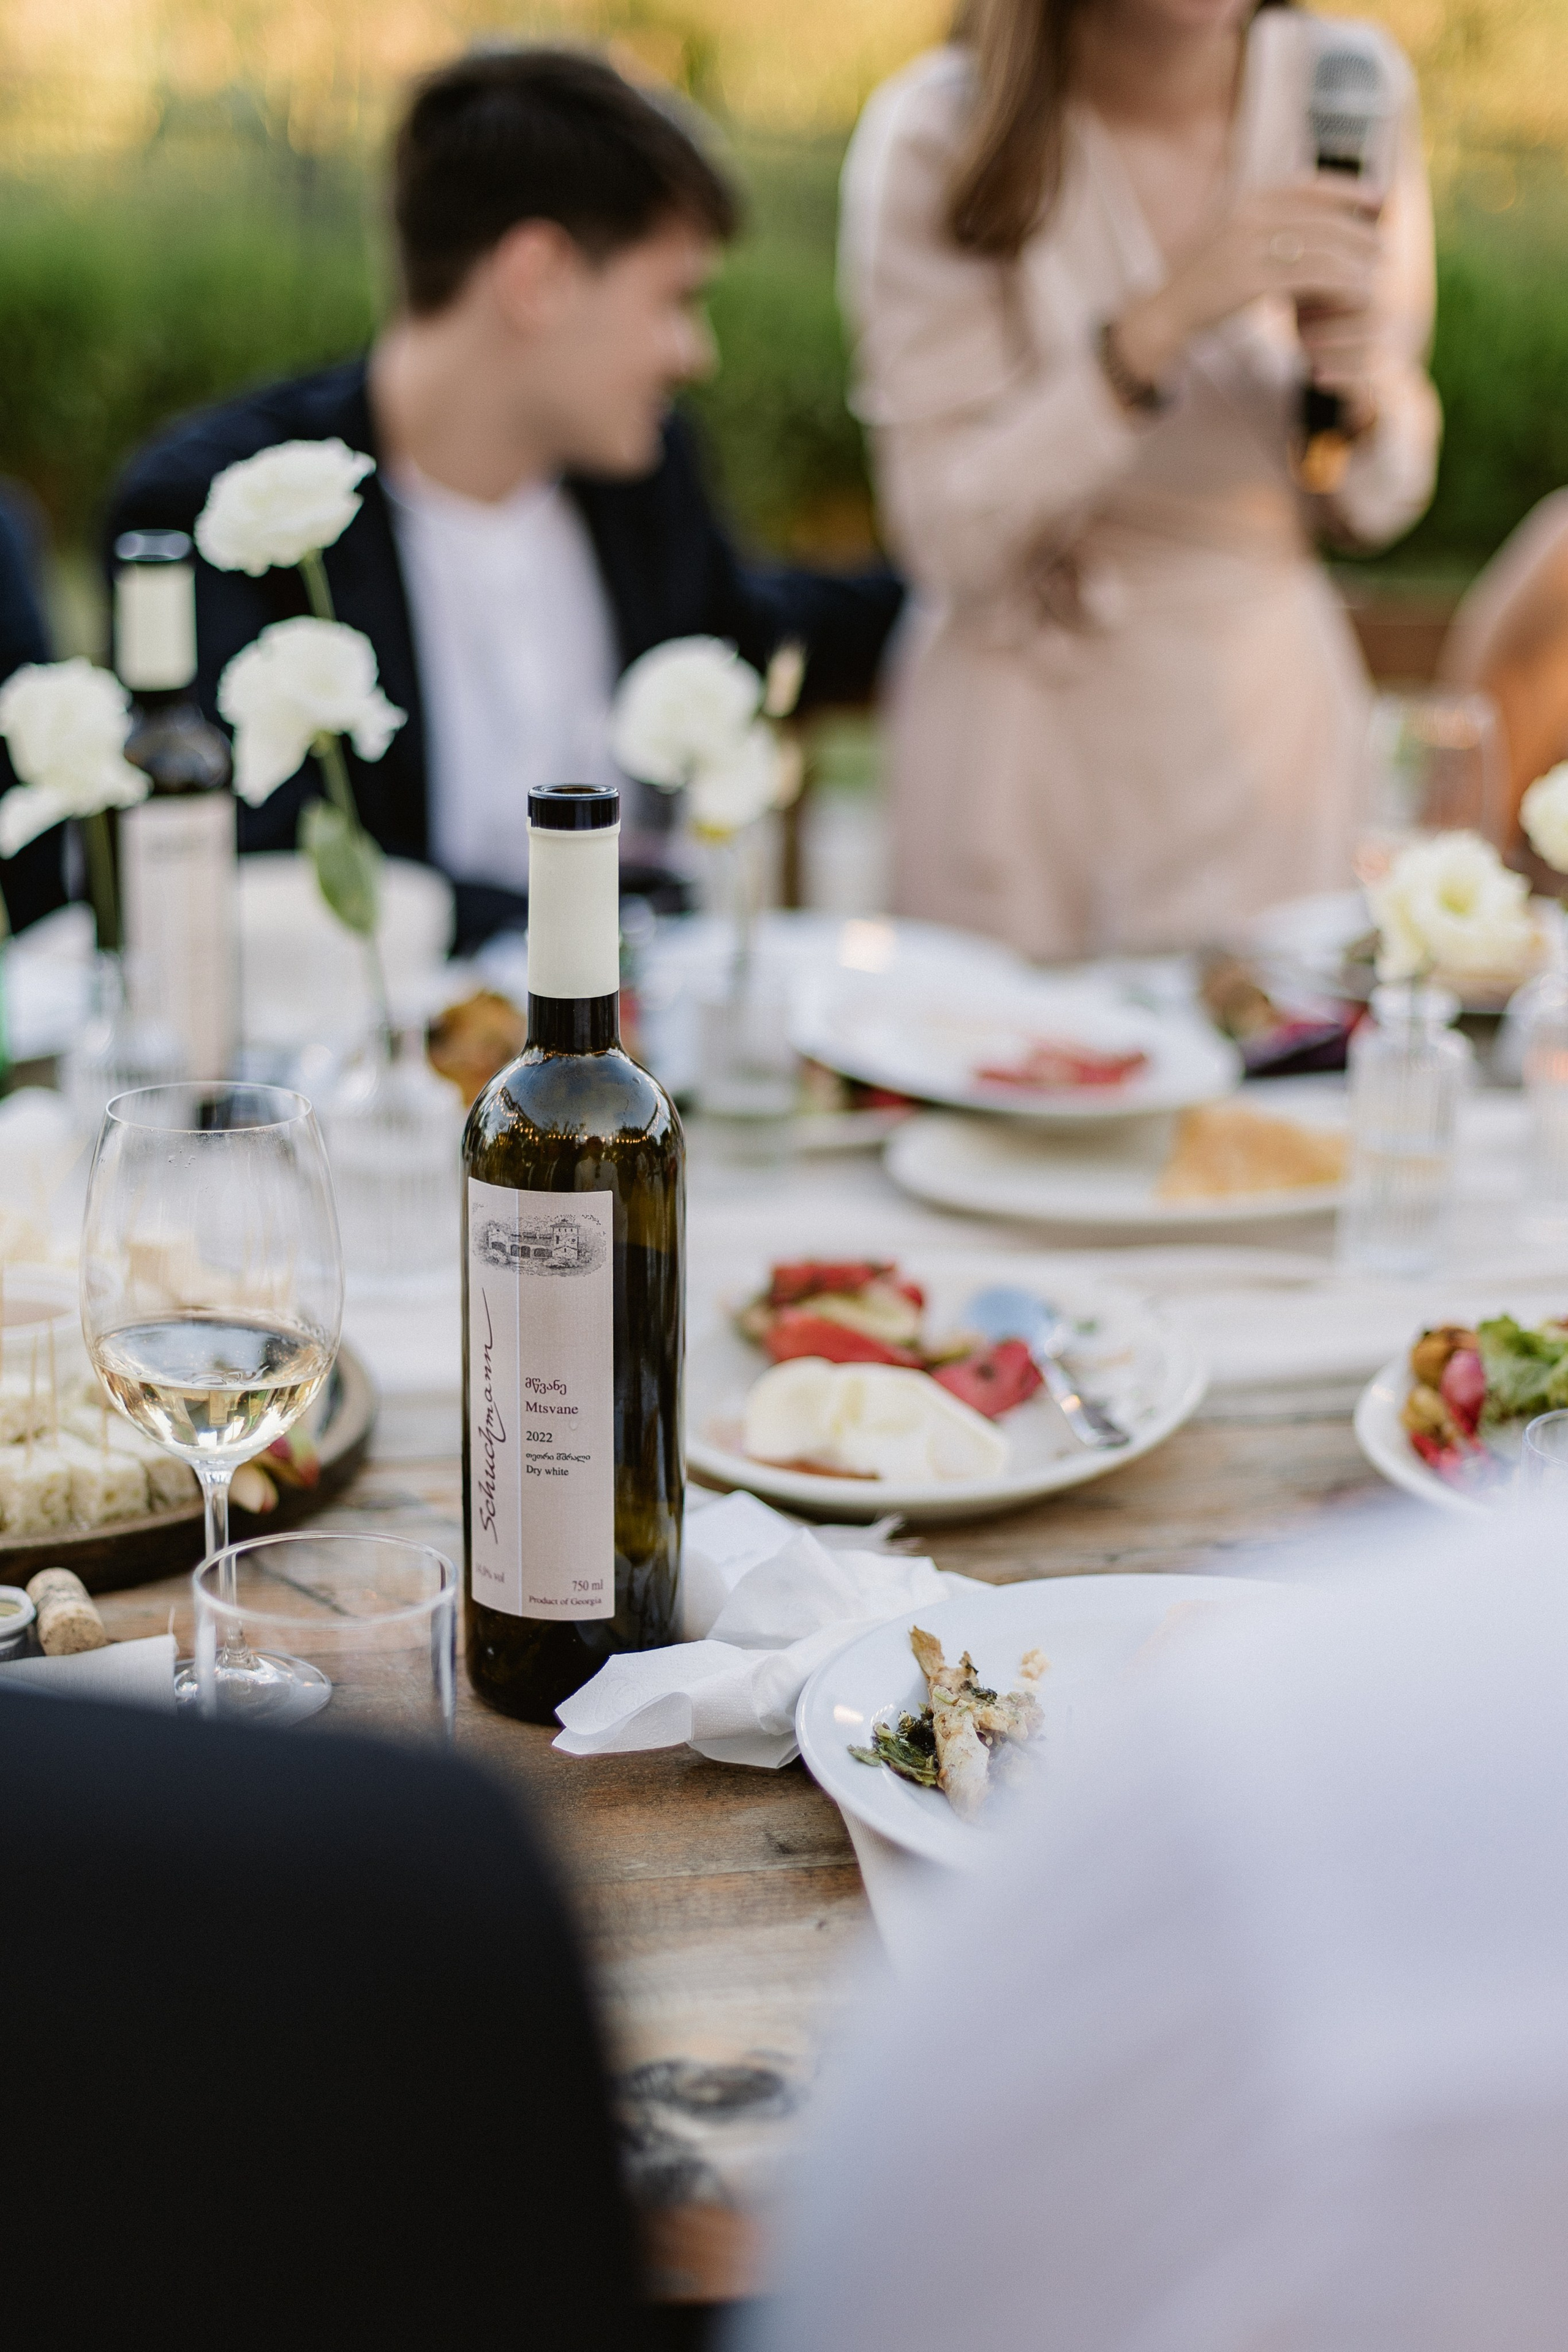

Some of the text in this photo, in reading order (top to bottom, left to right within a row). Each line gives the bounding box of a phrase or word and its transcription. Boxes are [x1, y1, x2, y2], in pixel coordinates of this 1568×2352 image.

[525, 1377, 567, 1395] მწვანე
[525, 1400, 579, 1414] Mtsvane
[478, 1287, 507, 1545] Schuchmann
[526, 1430, 553, 1443] 2022
[526, 1452, 554, 1462] თეთრი
[526, 1464, 570, 1477] Dry white
[572, 1578, 604, 1591] 750 ml
[529, 1594, 559, 1605] Product
[570, 1596, 602, 1606] Georgia
